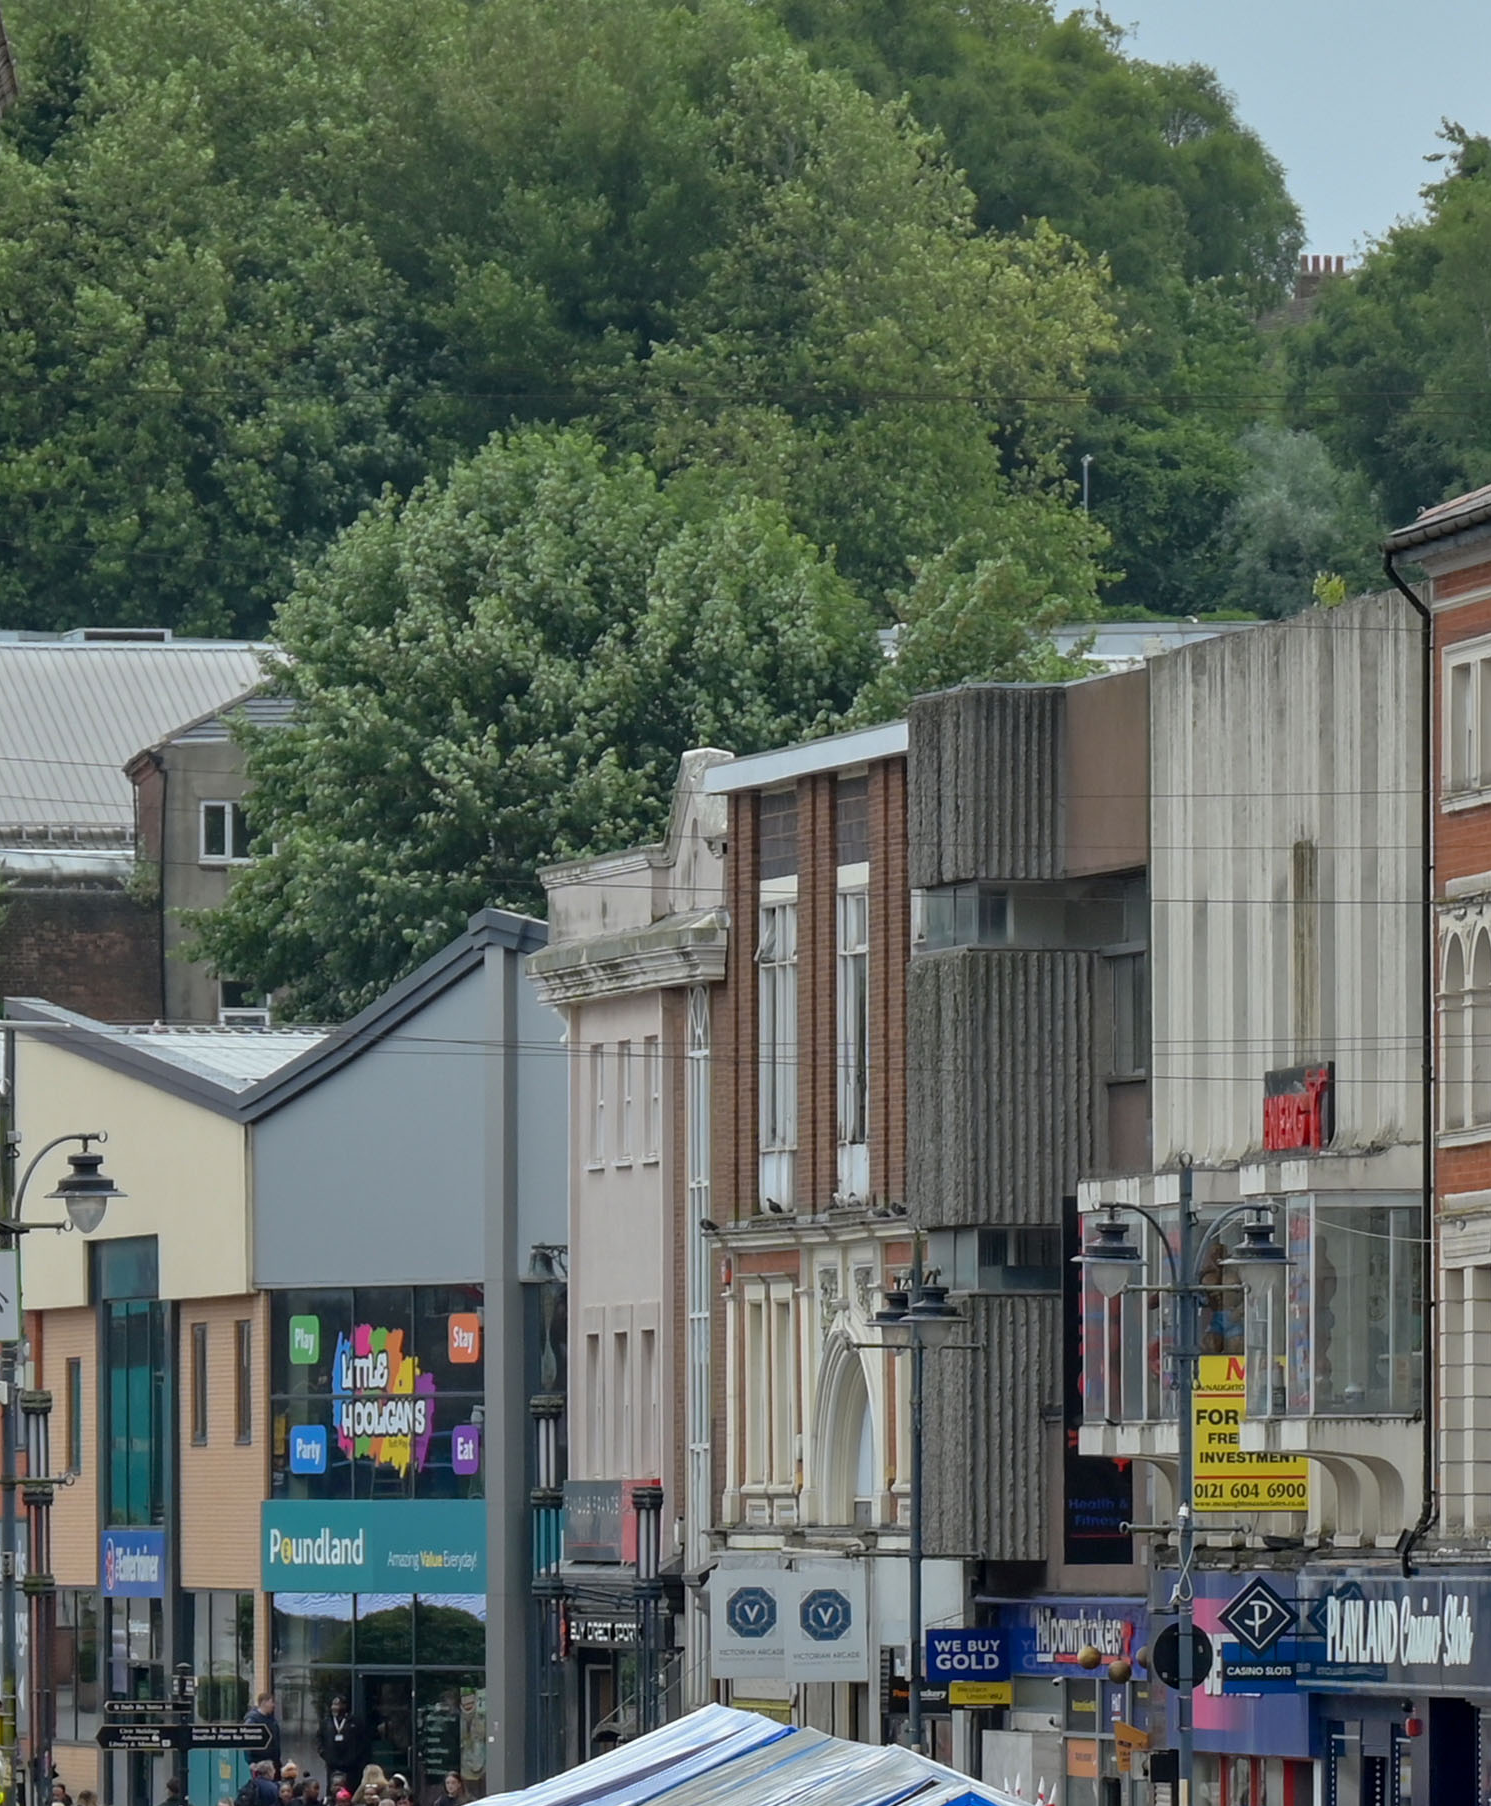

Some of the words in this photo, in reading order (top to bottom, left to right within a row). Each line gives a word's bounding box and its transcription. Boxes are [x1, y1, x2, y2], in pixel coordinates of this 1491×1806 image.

[294, 1328, 315, 1355] Play
[452, 1326, 474, 1353] Stay
[1196, 1409, 1238, 1425] FOR
[296, 1439, 321, 1464] Party
[457, 1437, 474, 1460] Eat
[1199, 1450, 1298, 1463] INVESTMENT
[1194, 1483, 1224, 1498] 0121
[1230, 1483, 1260, 1498] 604
[1267, 1483, 1305, 1498] 6900
[270, 1528, 363, 1565] Poundland
[388, 1551, 420, 1572] Amazing
[421, 1551, 442, 1568] Value
[443, 1551, 477, 1572] Everyday!
[1326, 1596, 1397, 1663] PLAYLAND
[934, 1640, 962, 1652] WE
[967, 1640, 1000, 1652] BUY
[935, 1654, 999, 1670] GOLD
[1227, 1666, 1263, 1676] CASINO
[1265, 1666, 1291, 1676] SLOTS
